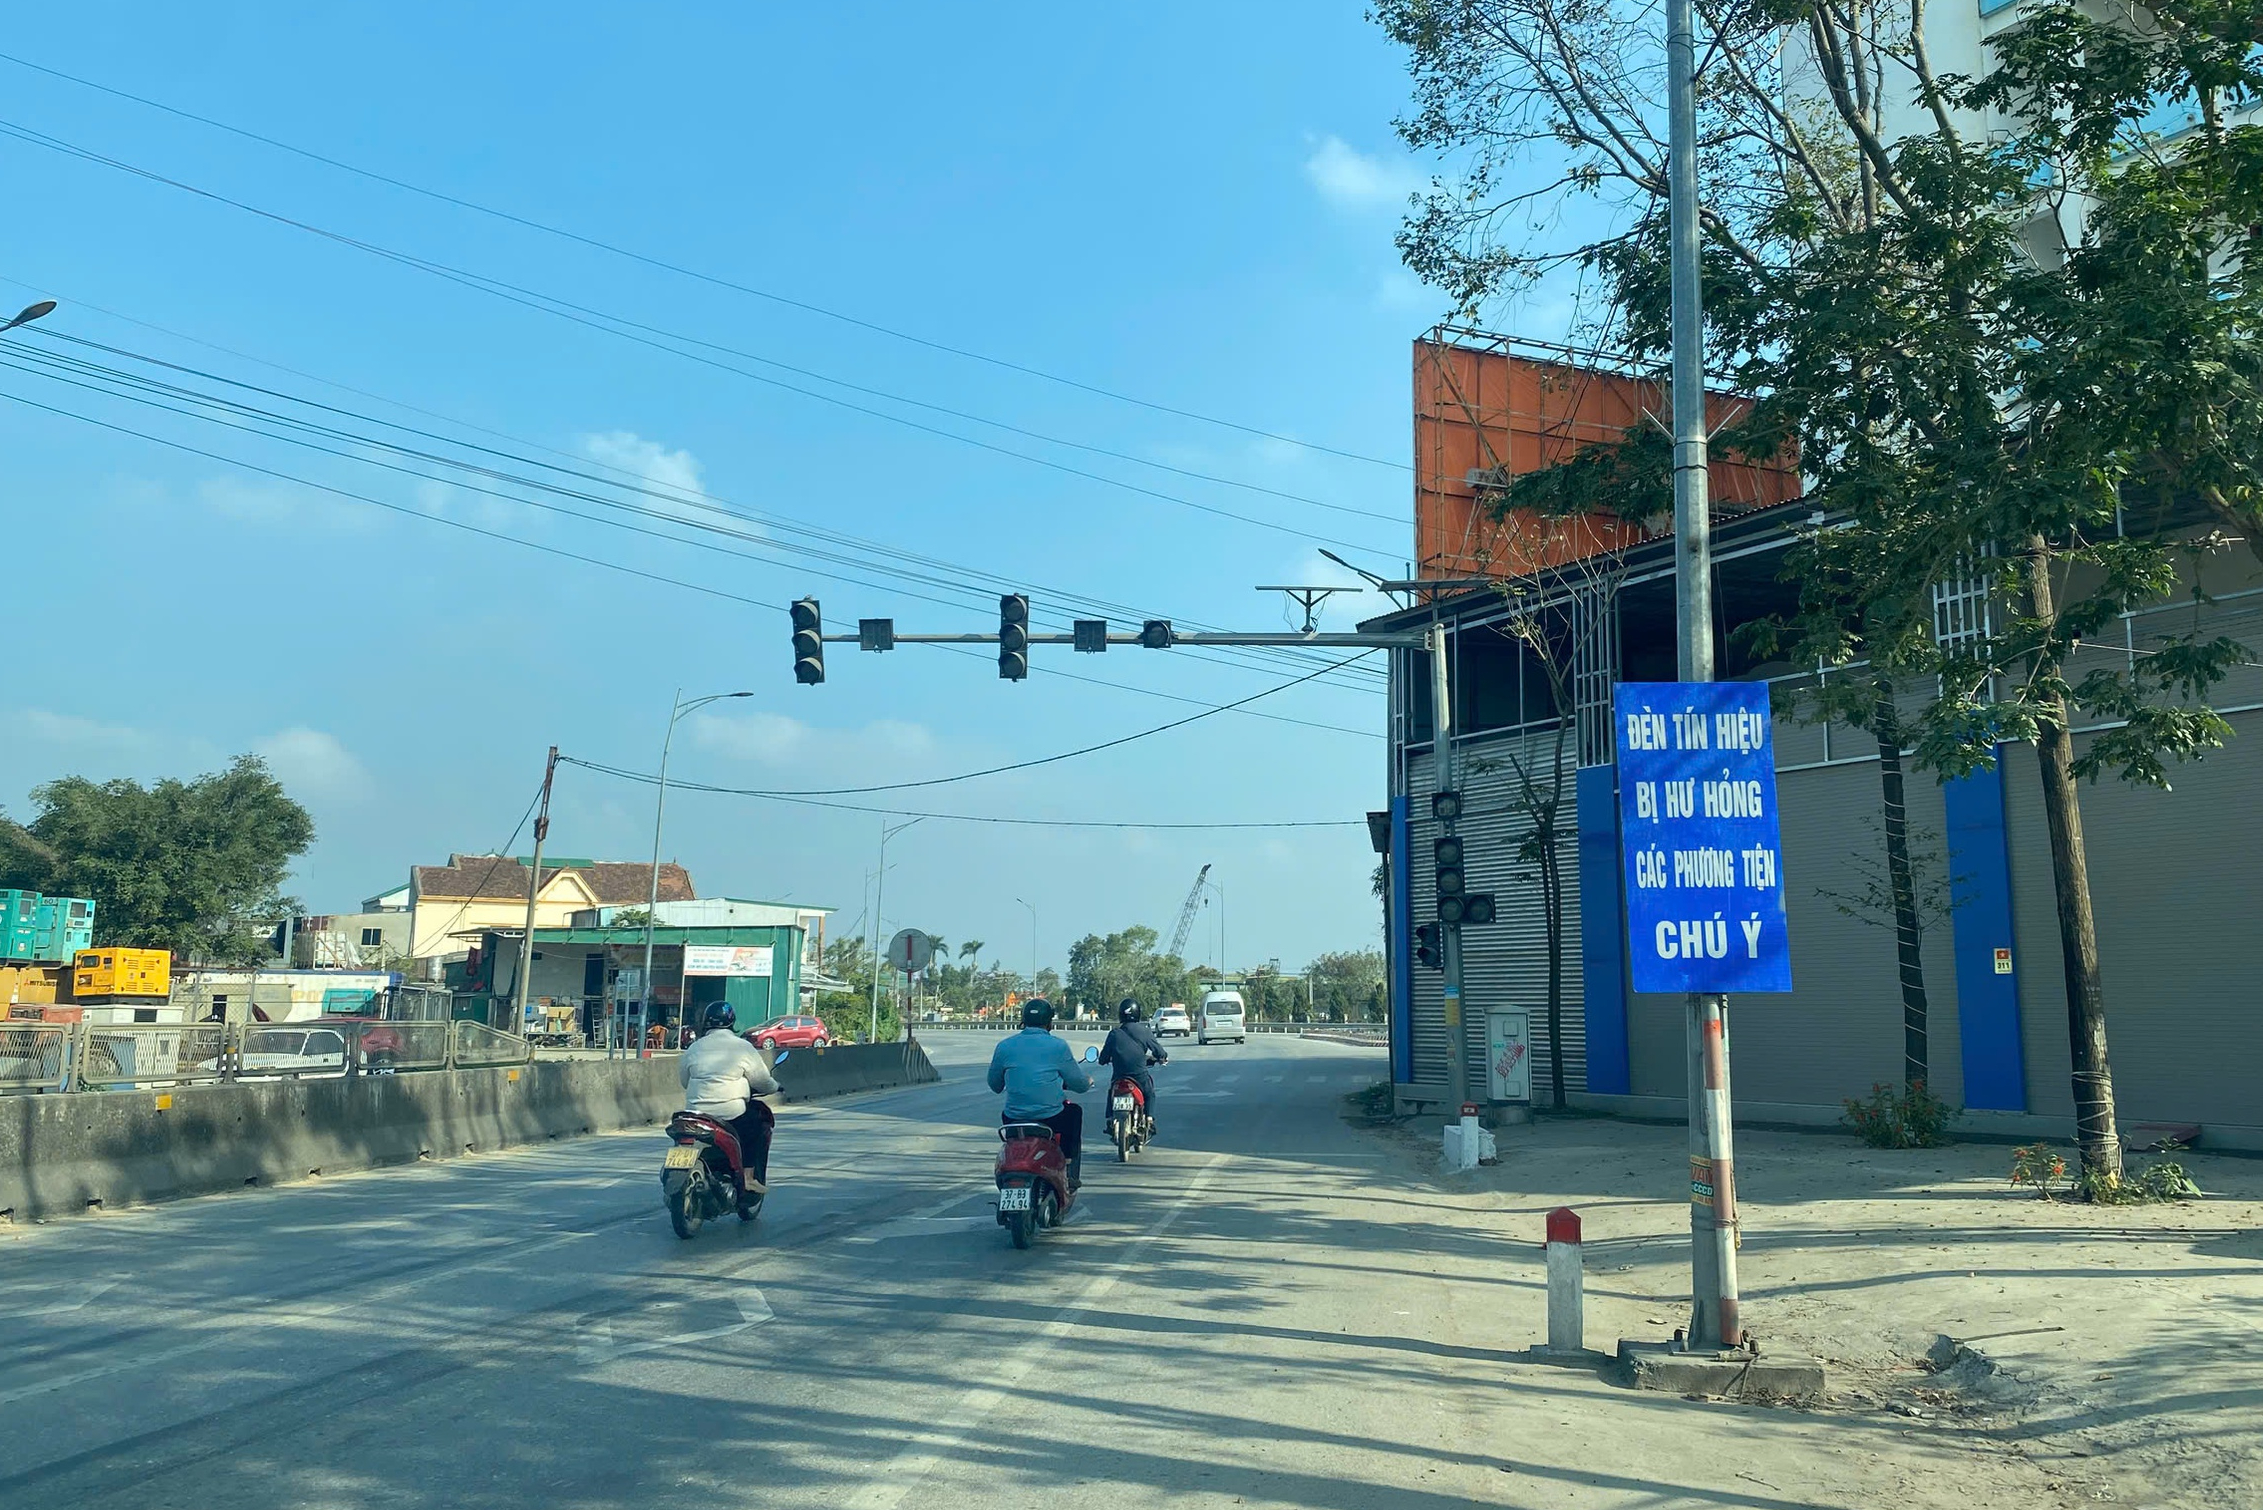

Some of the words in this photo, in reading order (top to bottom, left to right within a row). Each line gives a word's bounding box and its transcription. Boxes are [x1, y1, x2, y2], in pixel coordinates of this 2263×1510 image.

[1627, 706, 1667, 750] ĐÈN
[1672, 706, 1708, 750] TÍN
[1716, 706, 1763, 755] HIỆU
[1636, 781, 1659, 824] BỊ
[1665, 777, 1696, 818] HƯ
[1703, 768, 1763, 818] HỎNG
[1636, 843, 1667, 889] CÁC
[1673, 846, 1735, 888] PHƯƠNG
[1741, 842, 1776, 891] TIỆN
[1655, 911, 1728, 959] CHÚ
[1740, 911, 1762, 959] Ý
